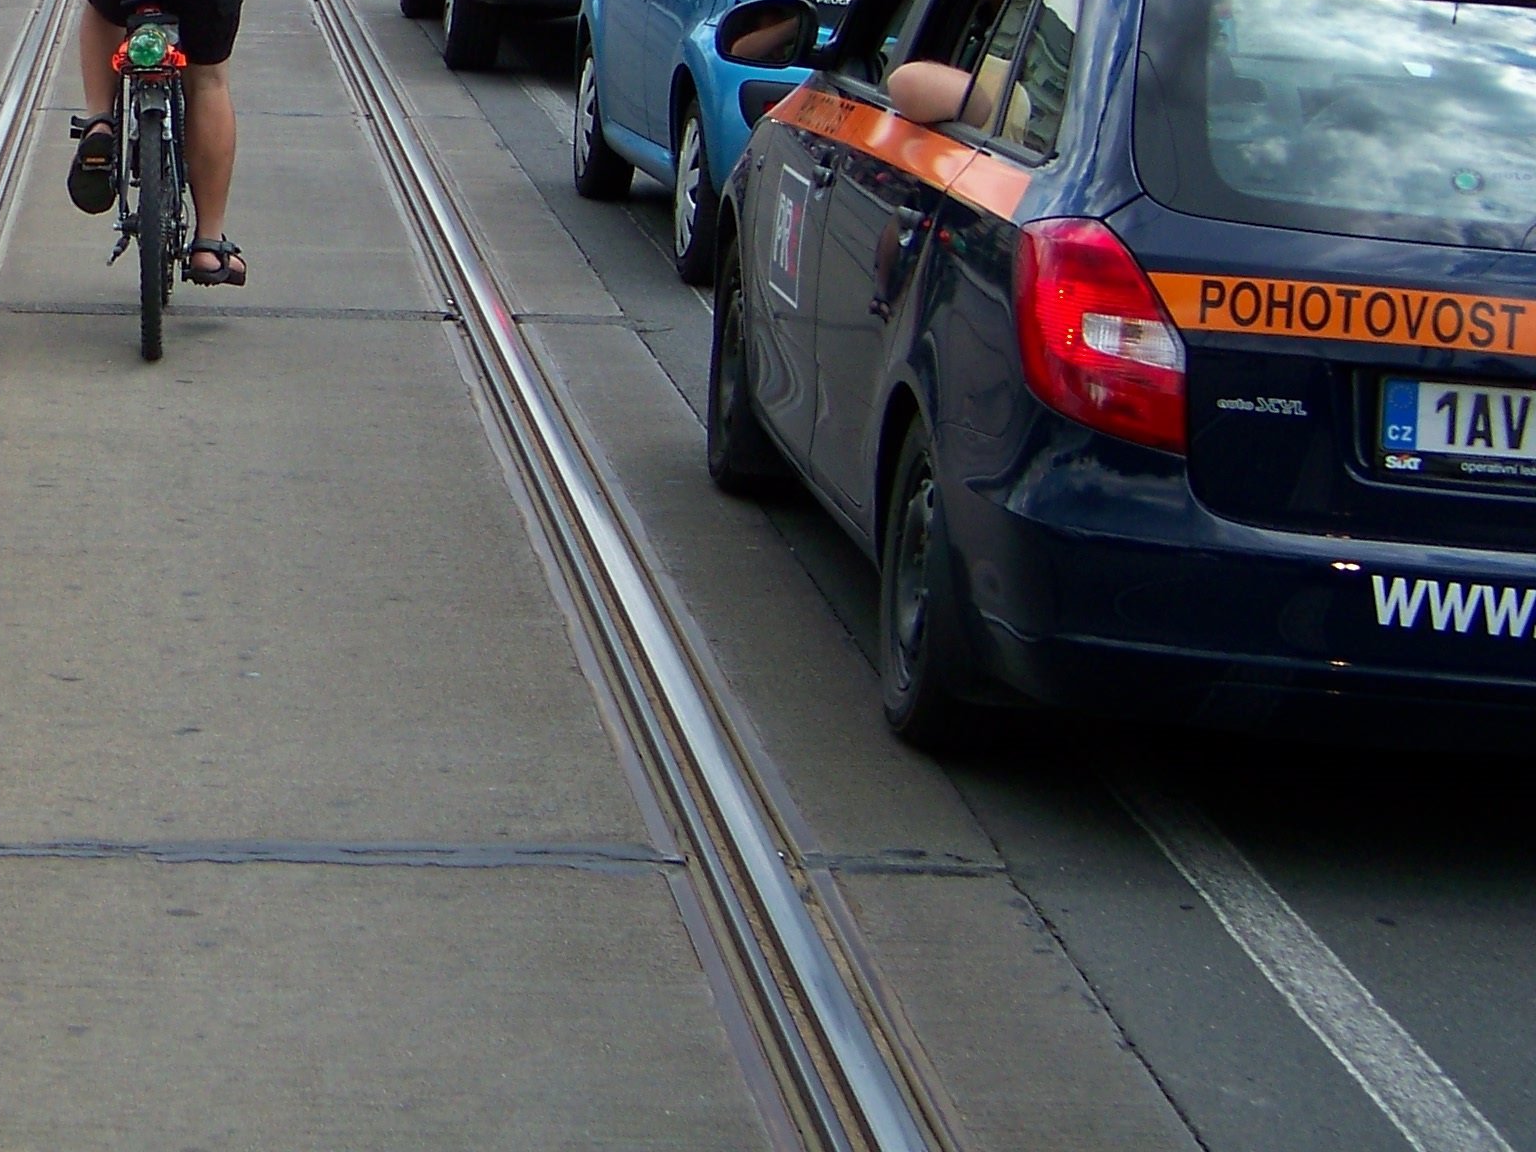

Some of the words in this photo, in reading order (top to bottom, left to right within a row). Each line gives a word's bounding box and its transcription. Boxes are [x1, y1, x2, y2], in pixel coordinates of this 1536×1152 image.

[1198, 279, 1527, 350] POHOTOVOST
[1387, 424, 1413, 442] CZ
[1434, 390, 1532, 450] 1AV
[1371, 574, 1536, 639] WWW
